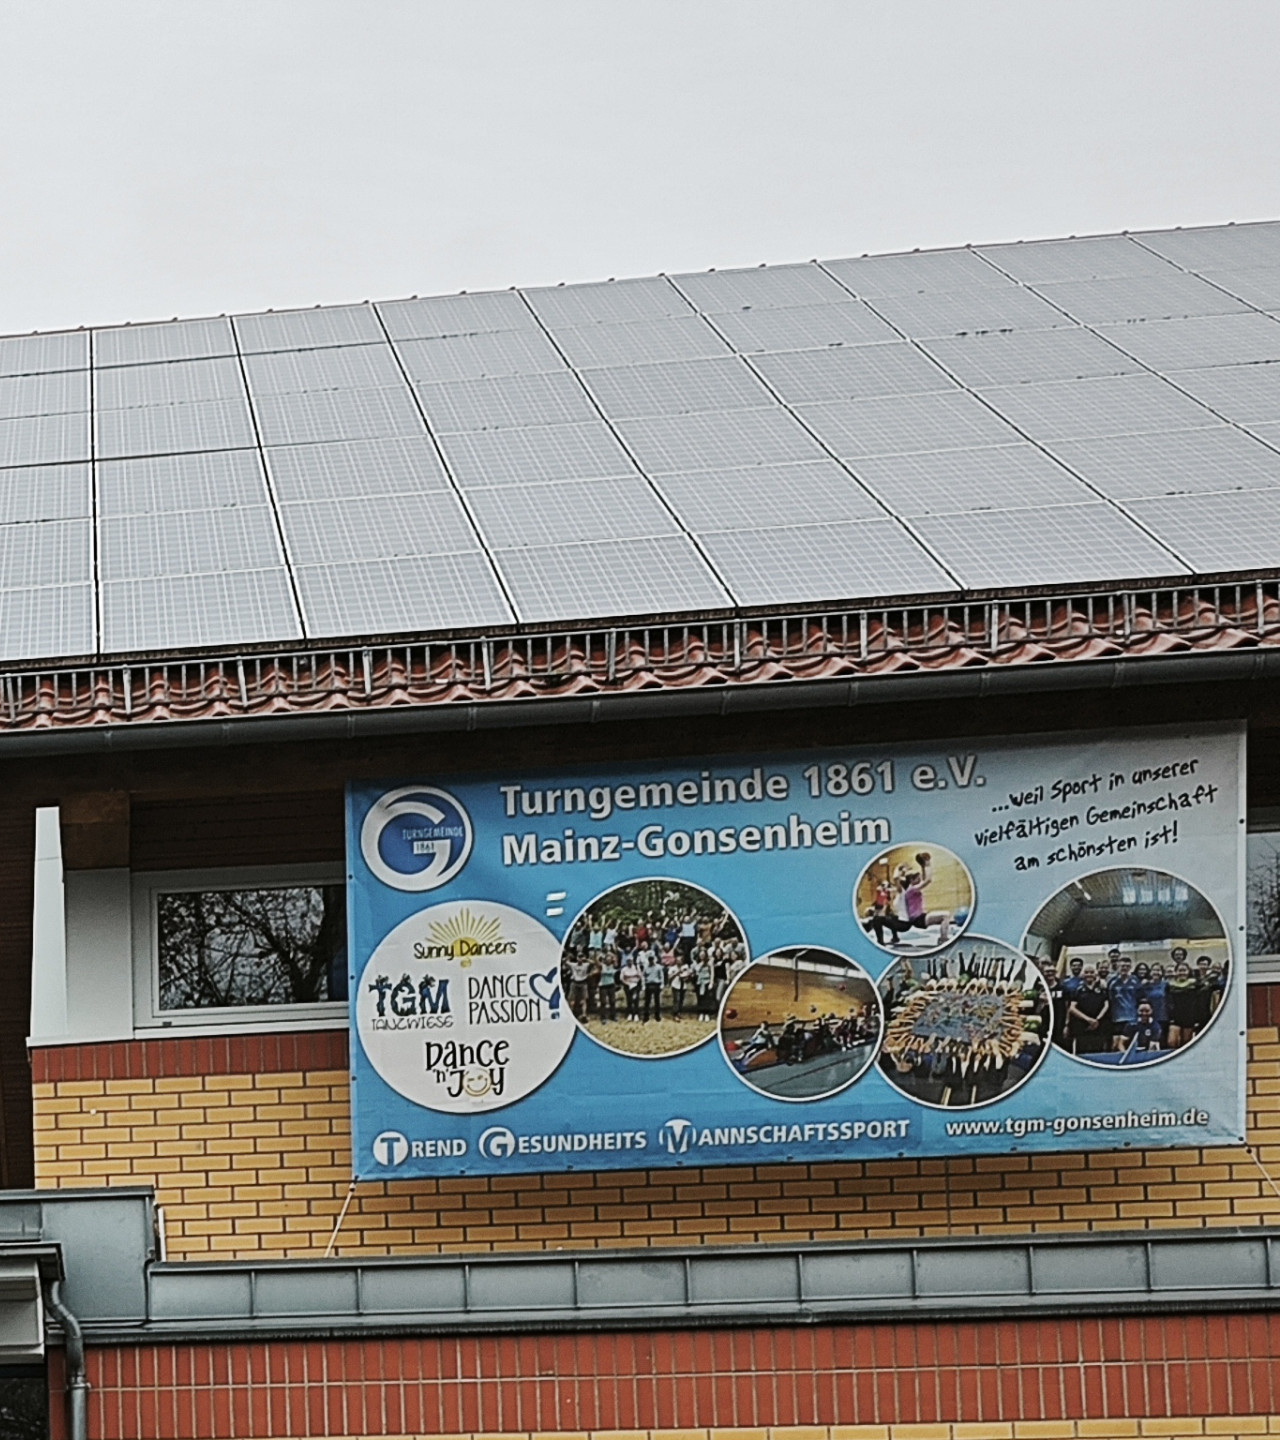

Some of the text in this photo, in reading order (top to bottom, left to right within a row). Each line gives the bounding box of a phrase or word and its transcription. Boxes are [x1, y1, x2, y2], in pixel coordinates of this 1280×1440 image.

[500, 755, 986, 819] Turngemeinde 1861 e.V.
[1051, 774, 1102, 802] Sport
[1109, 773, 1125, 791] in
[1132, 759, 1199, 784] unserer
[402, 826, 464, 840] TURNGEMEINDE
[975, 784, 1218, 847] vielfältigen Gemeinschaft
[502, 812, 890, 865] Mainz-Gonsenheim
[1014, 820, 1178, 871] am schönsten ist!
[414, 940, 517, 960] Sunny Dancers
[469, 974, 528, 999] DANCE
[469, 999, 541, 1024] PASSION
[373, 1119, 910, 1166] TREND GESUNDHEITS MANNSCHAFTSSPORT
[946, 1108, 1210, 1137] www.tgm-gonsenheim.de
